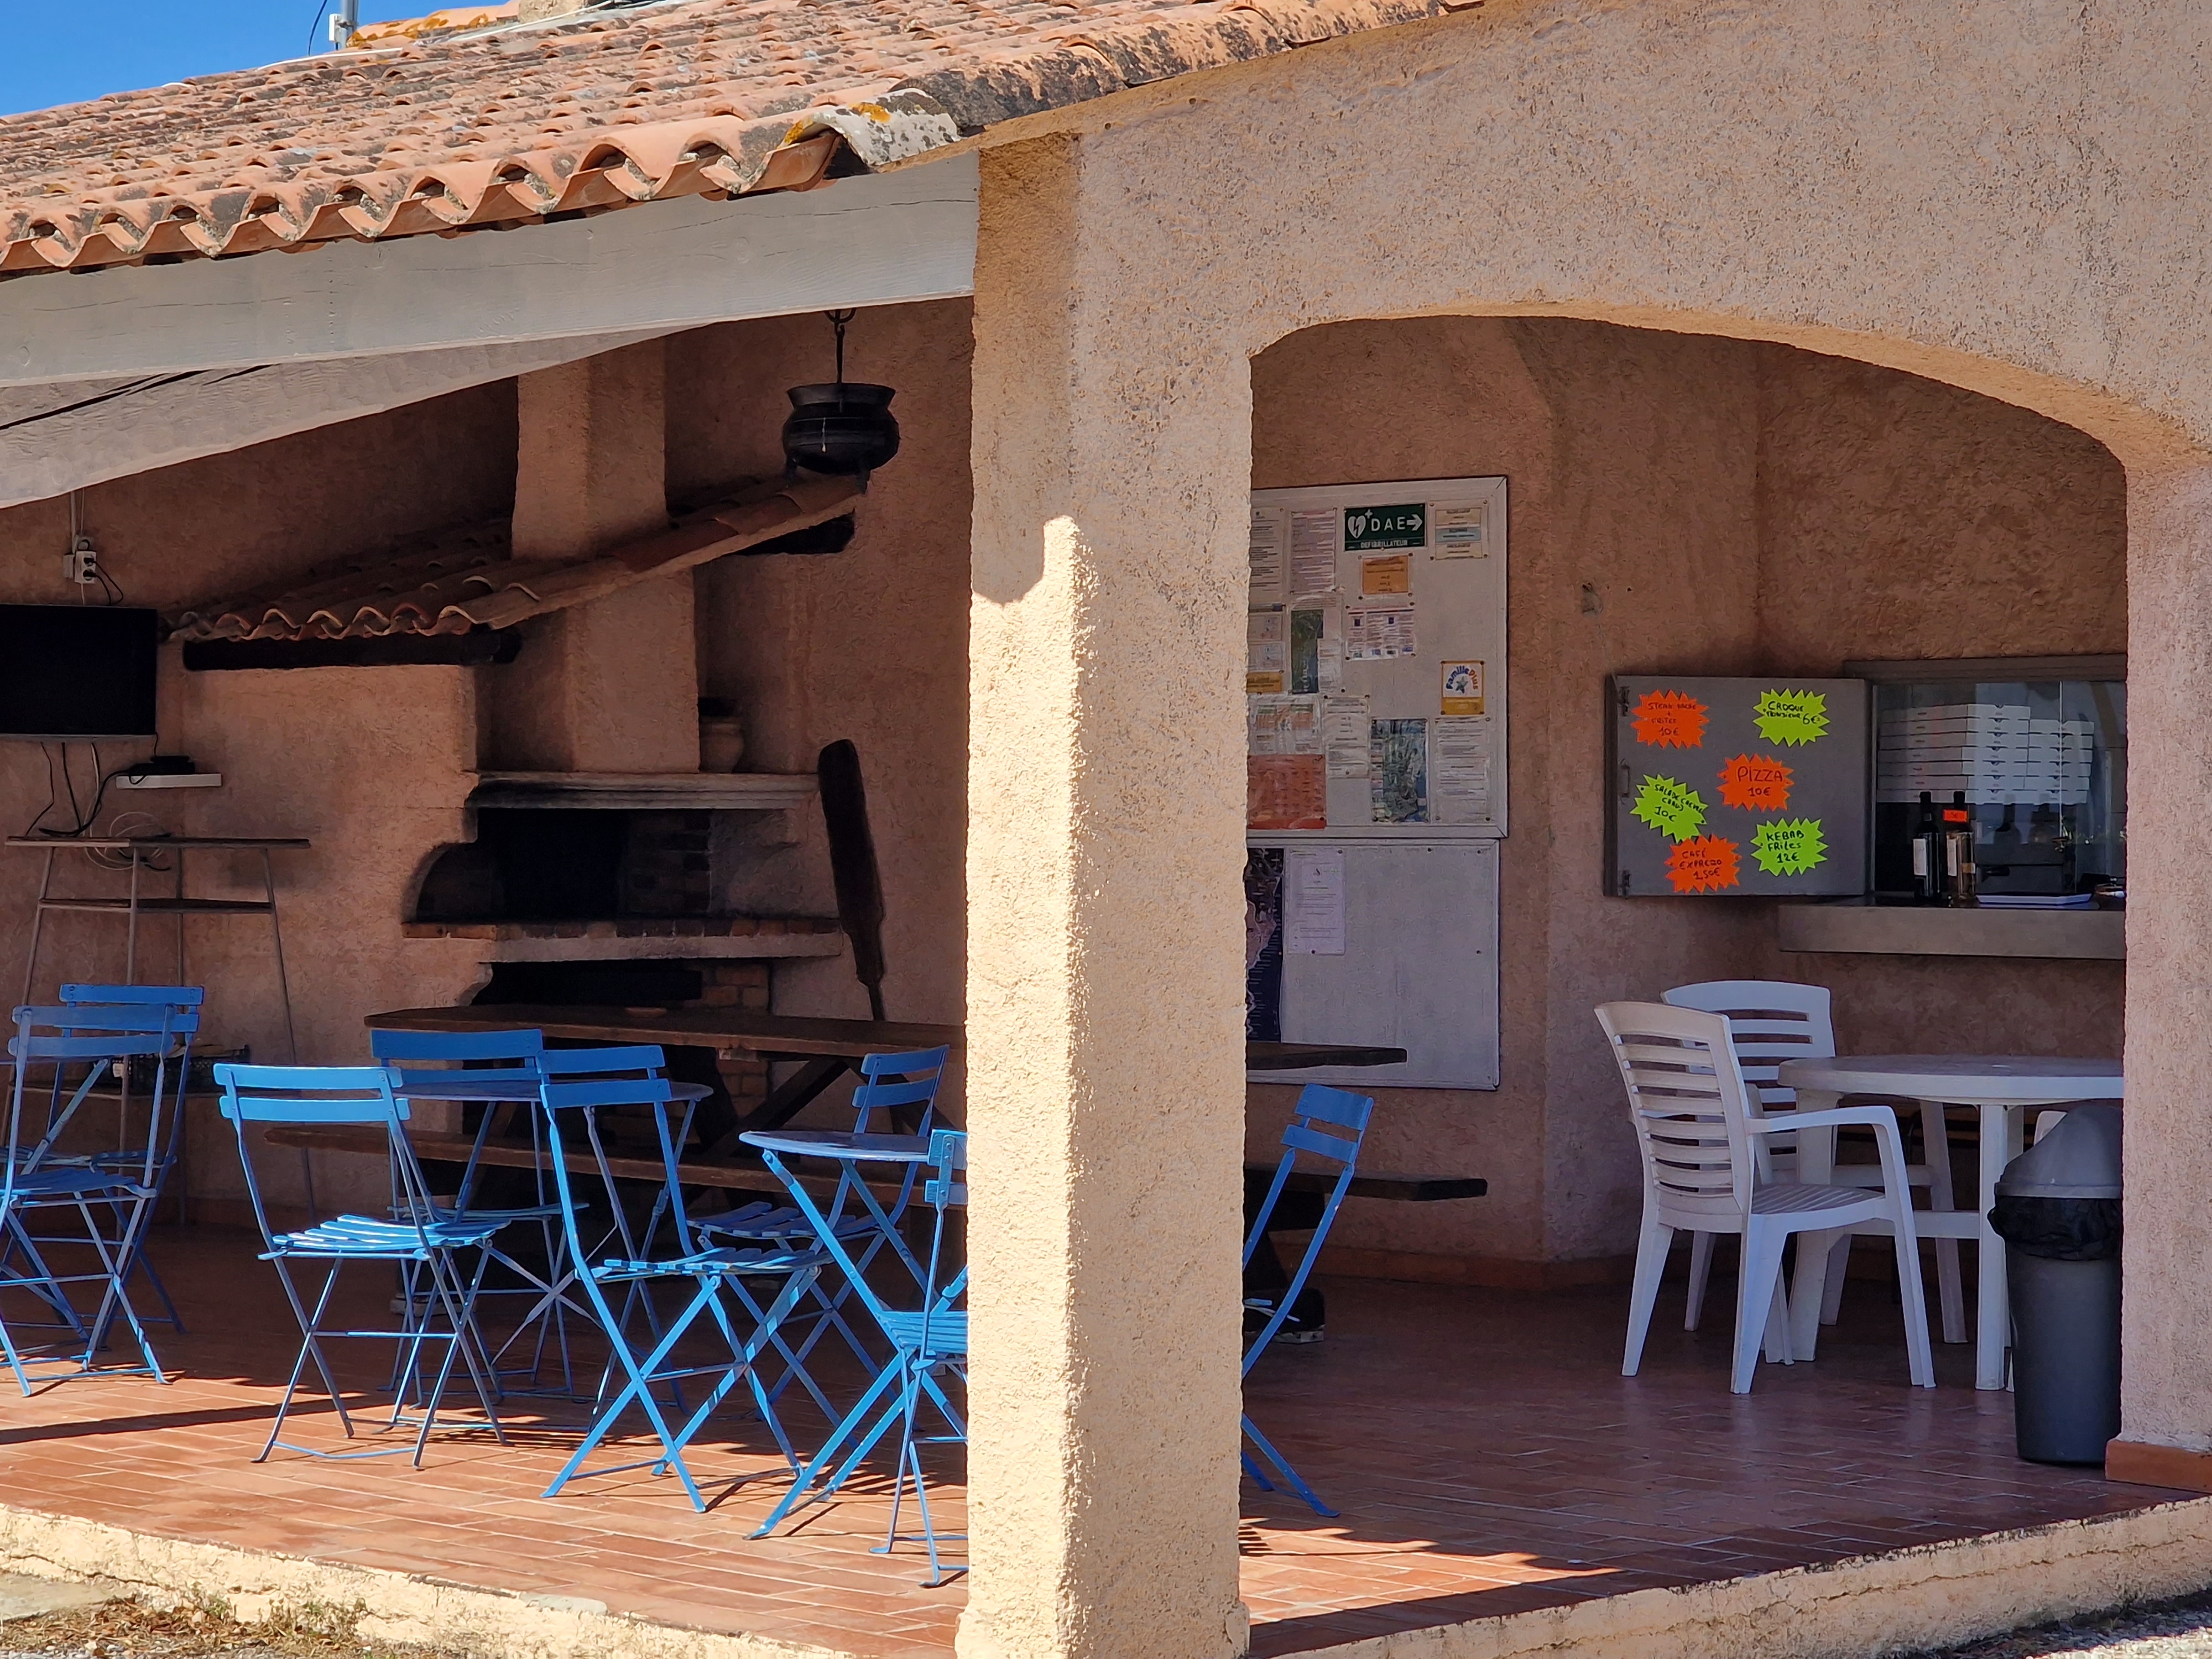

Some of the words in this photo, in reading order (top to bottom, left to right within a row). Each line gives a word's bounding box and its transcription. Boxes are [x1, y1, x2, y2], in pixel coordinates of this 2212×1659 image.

[1371, 516, 1406, 531] DAE
[1737, 765, 1783, 782] PIZZA
[1766, 830, 1804, 842] KEBAB
[1776, 852, 1799, 863] 12€
